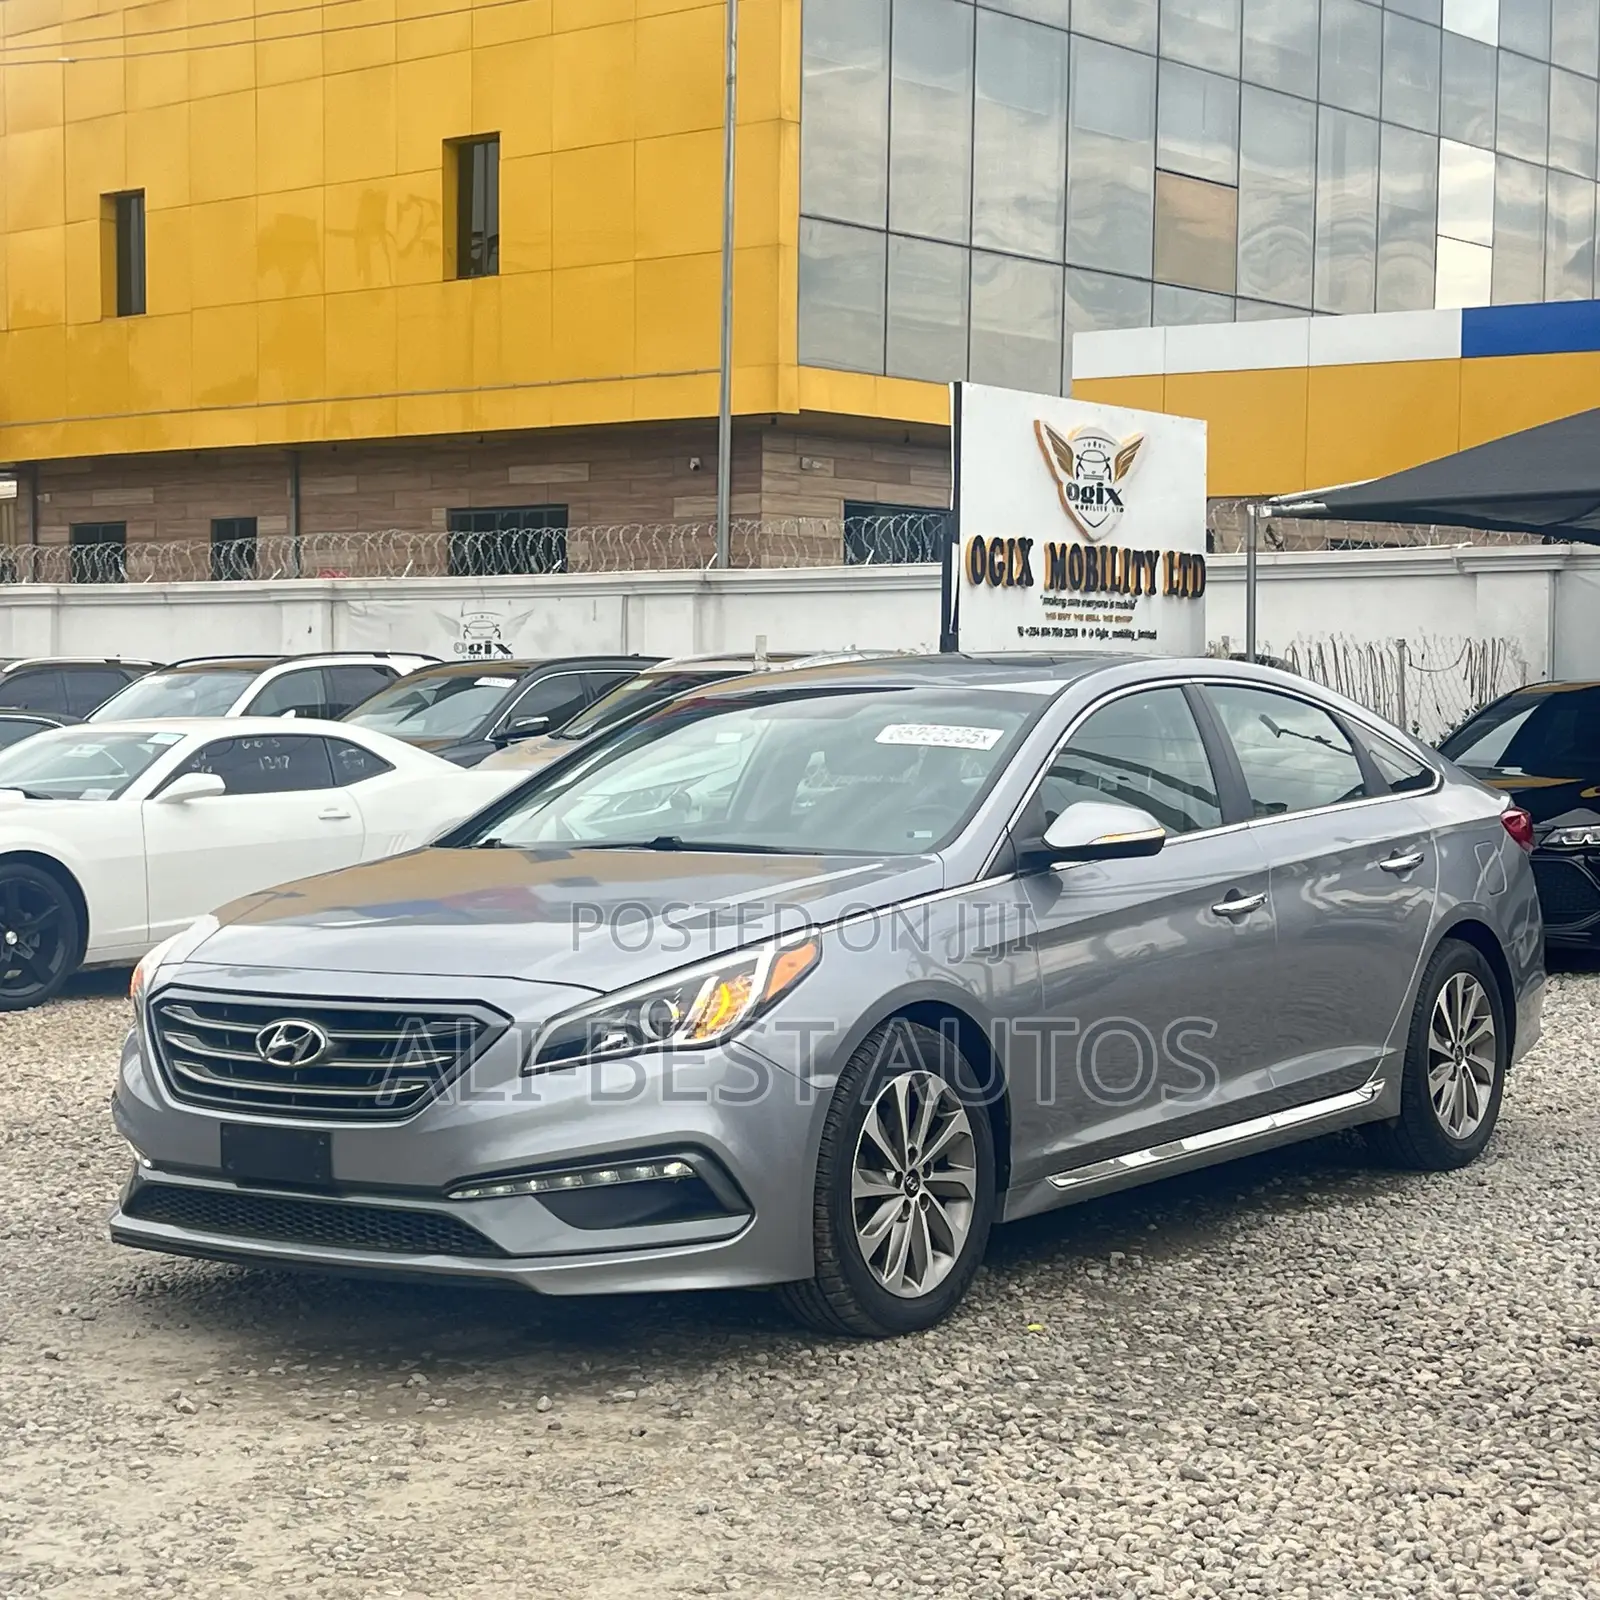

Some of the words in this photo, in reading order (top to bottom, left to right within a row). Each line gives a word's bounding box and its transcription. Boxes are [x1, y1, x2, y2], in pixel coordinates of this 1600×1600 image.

[1066, 482, 1124, 506] Ogix
[965, 535, 1034, 587] OGIX
[1044, 542, 1160, 596] MOBILITY
[1163, 550, 1206, 598] LTD
